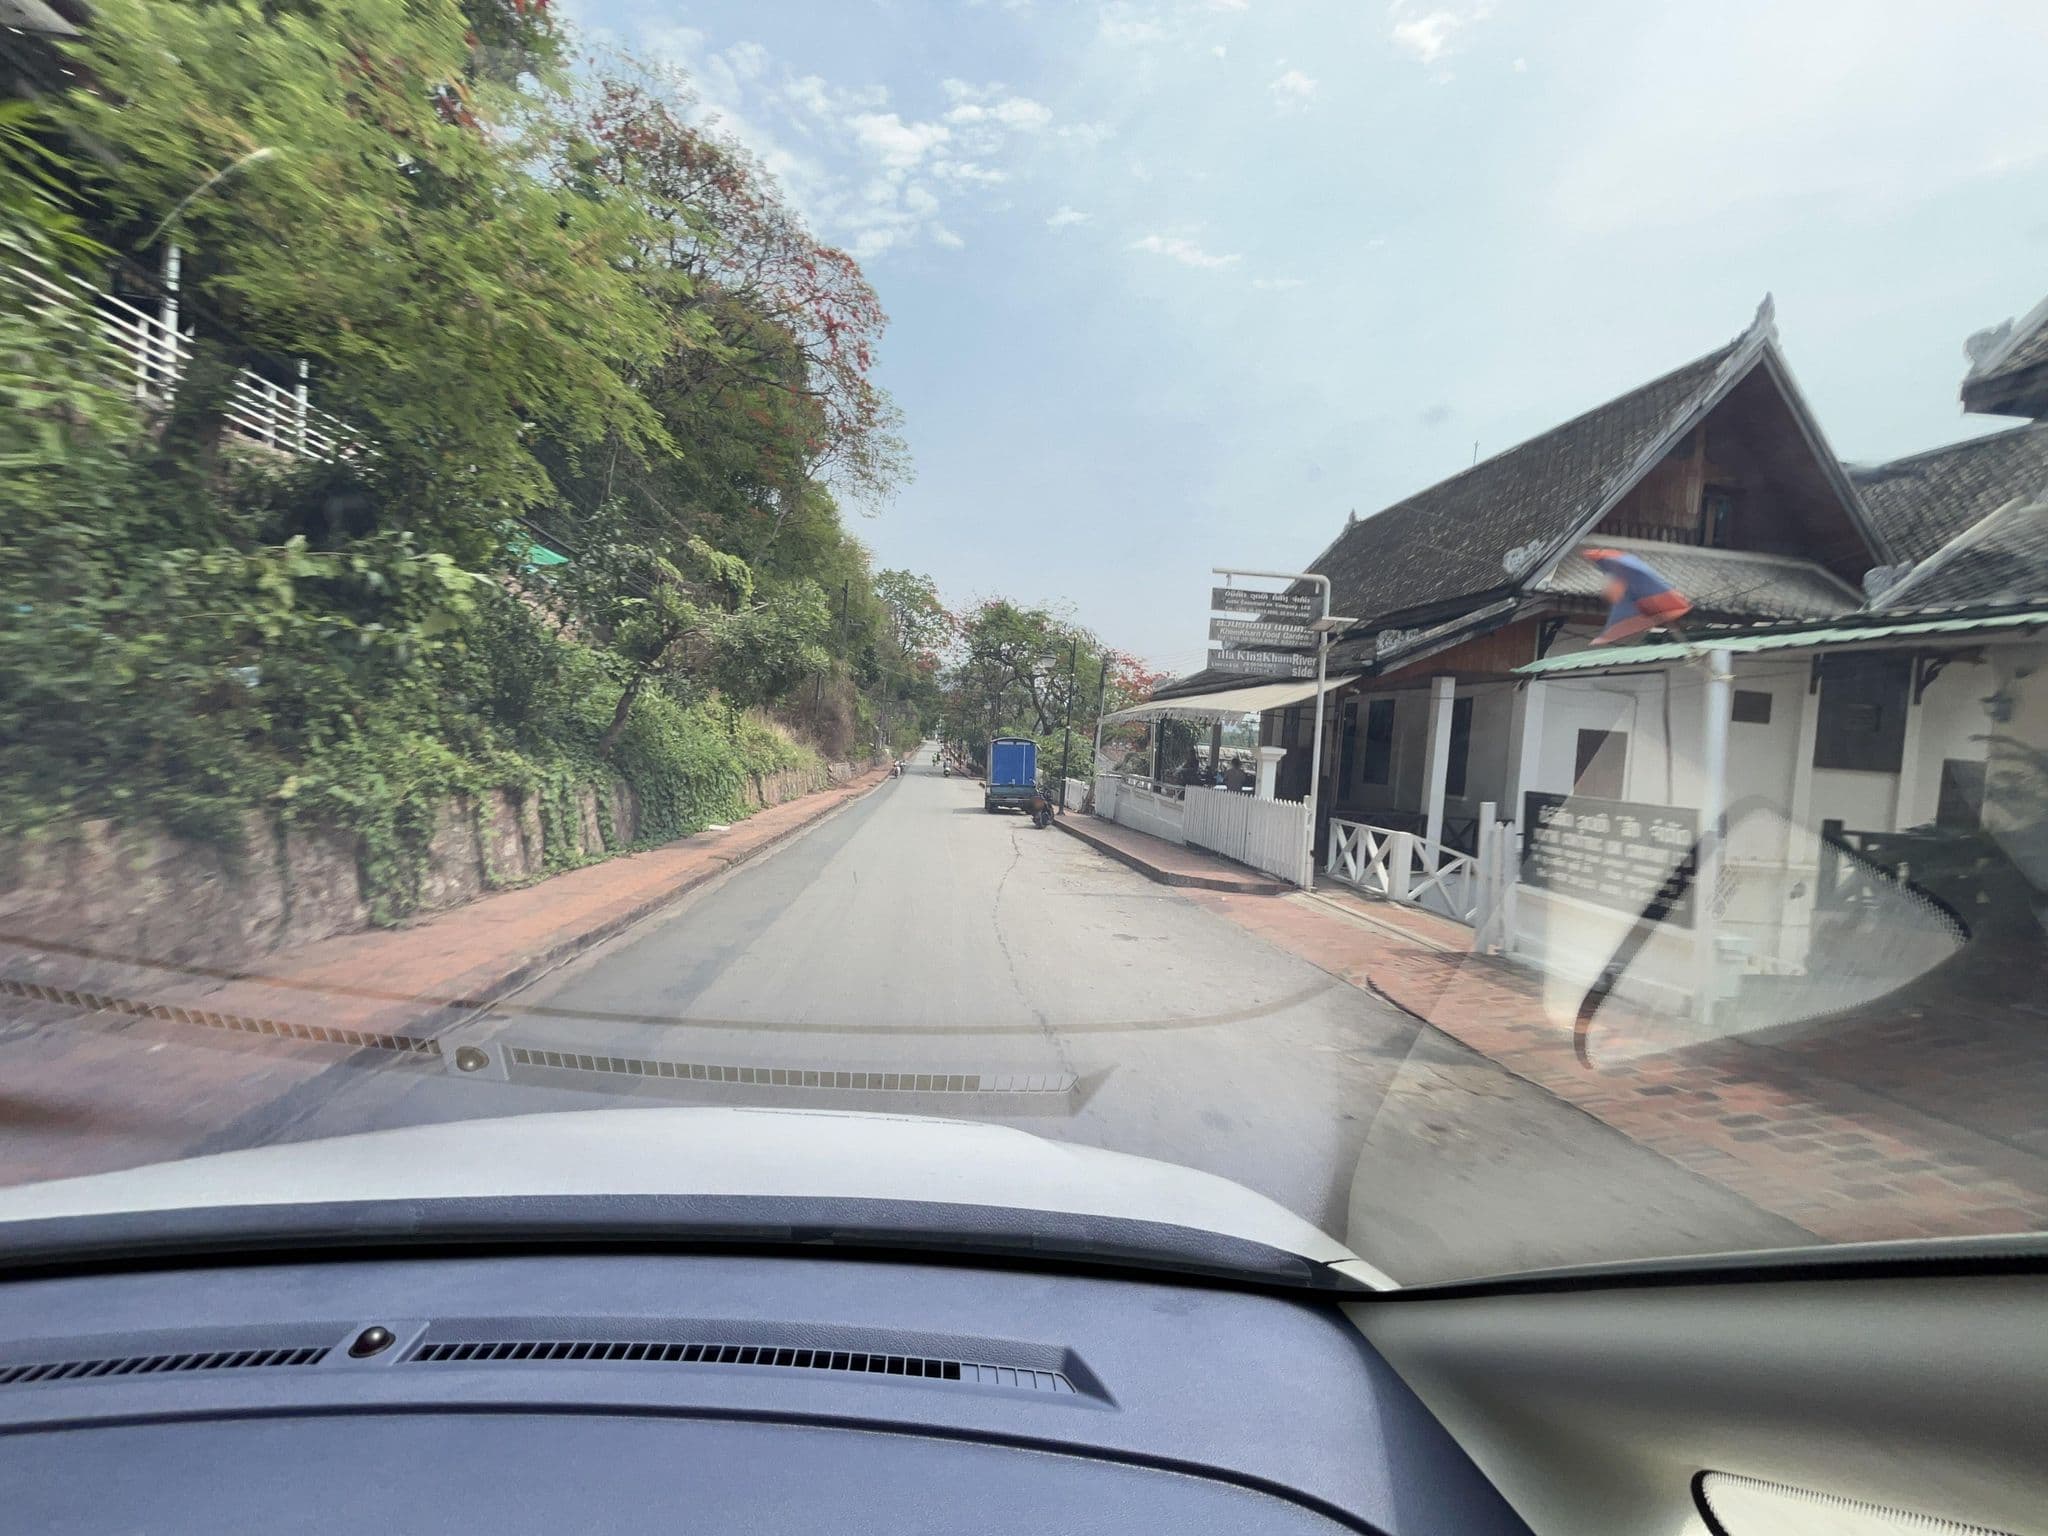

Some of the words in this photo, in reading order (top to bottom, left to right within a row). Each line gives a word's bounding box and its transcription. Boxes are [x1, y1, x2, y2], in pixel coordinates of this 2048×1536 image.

[1262, 630, 1281, 640] Food
[1283, 632, 1309, 641] Garden
[1292, 653, 1317, 666] River
[1292, 666, 1313, 677] side
